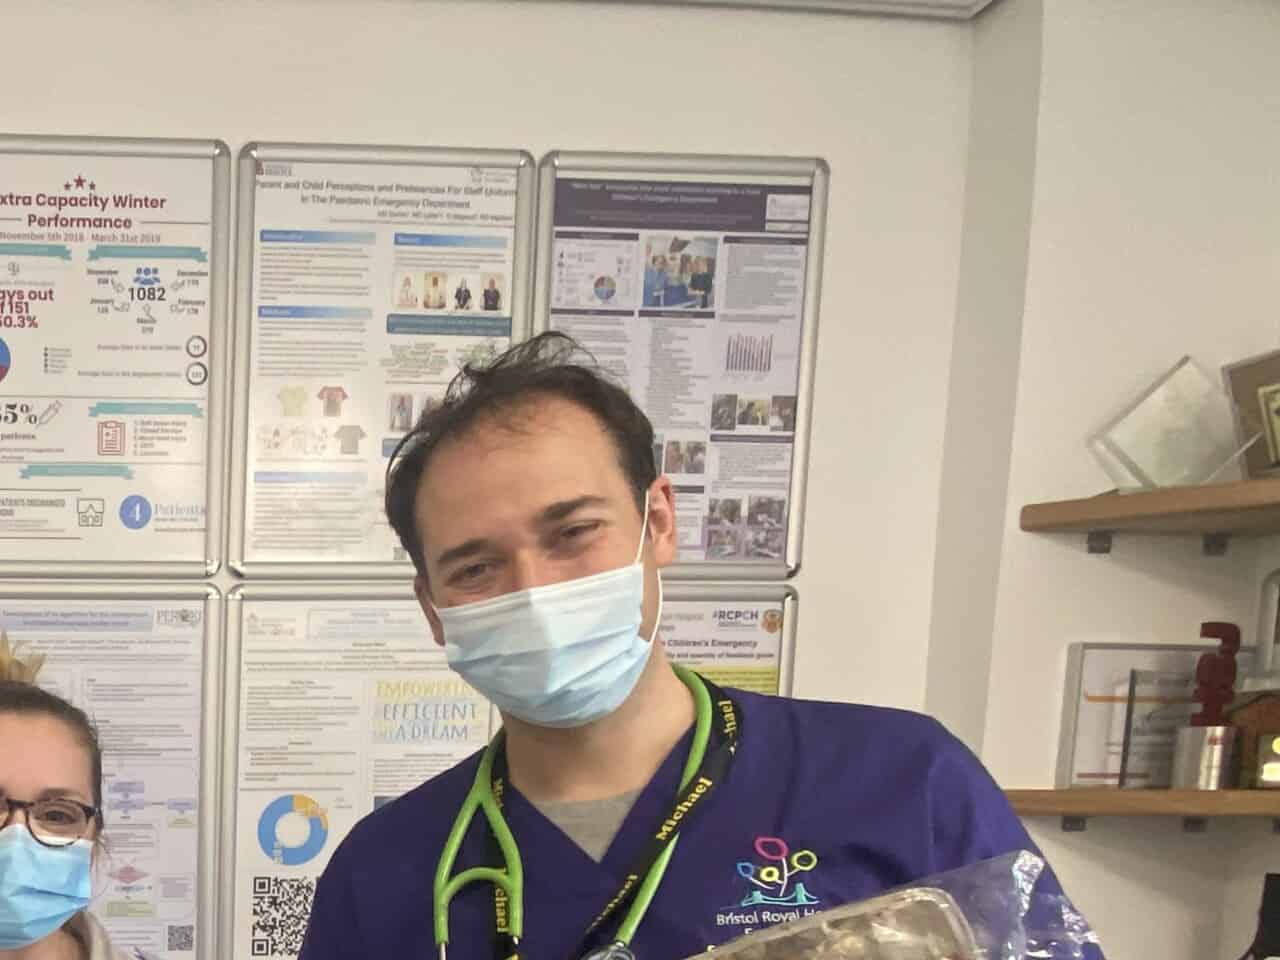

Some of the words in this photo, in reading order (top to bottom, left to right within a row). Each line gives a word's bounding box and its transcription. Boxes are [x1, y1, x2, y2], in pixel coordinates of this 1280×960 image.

[36, 193, 109, 211] Capacity
[113, 195, 166, 209] Winter
[373, 197, 420, 210] Emergency
[422, 198, 470, 209] Department
[27, 214, 132, 229] Performance
[91, 233, 119, 243] March
[28, 288, 54, 301] out
[128, 287, 166, 301] 1082
[8, 301, 29, 314] 151
[711, 640, 758, 649] Emergency
[656, 777, 713, 842] Michael
[716, 911, 759, 926] Bristol
[761, 908, 800, 923] Royal
